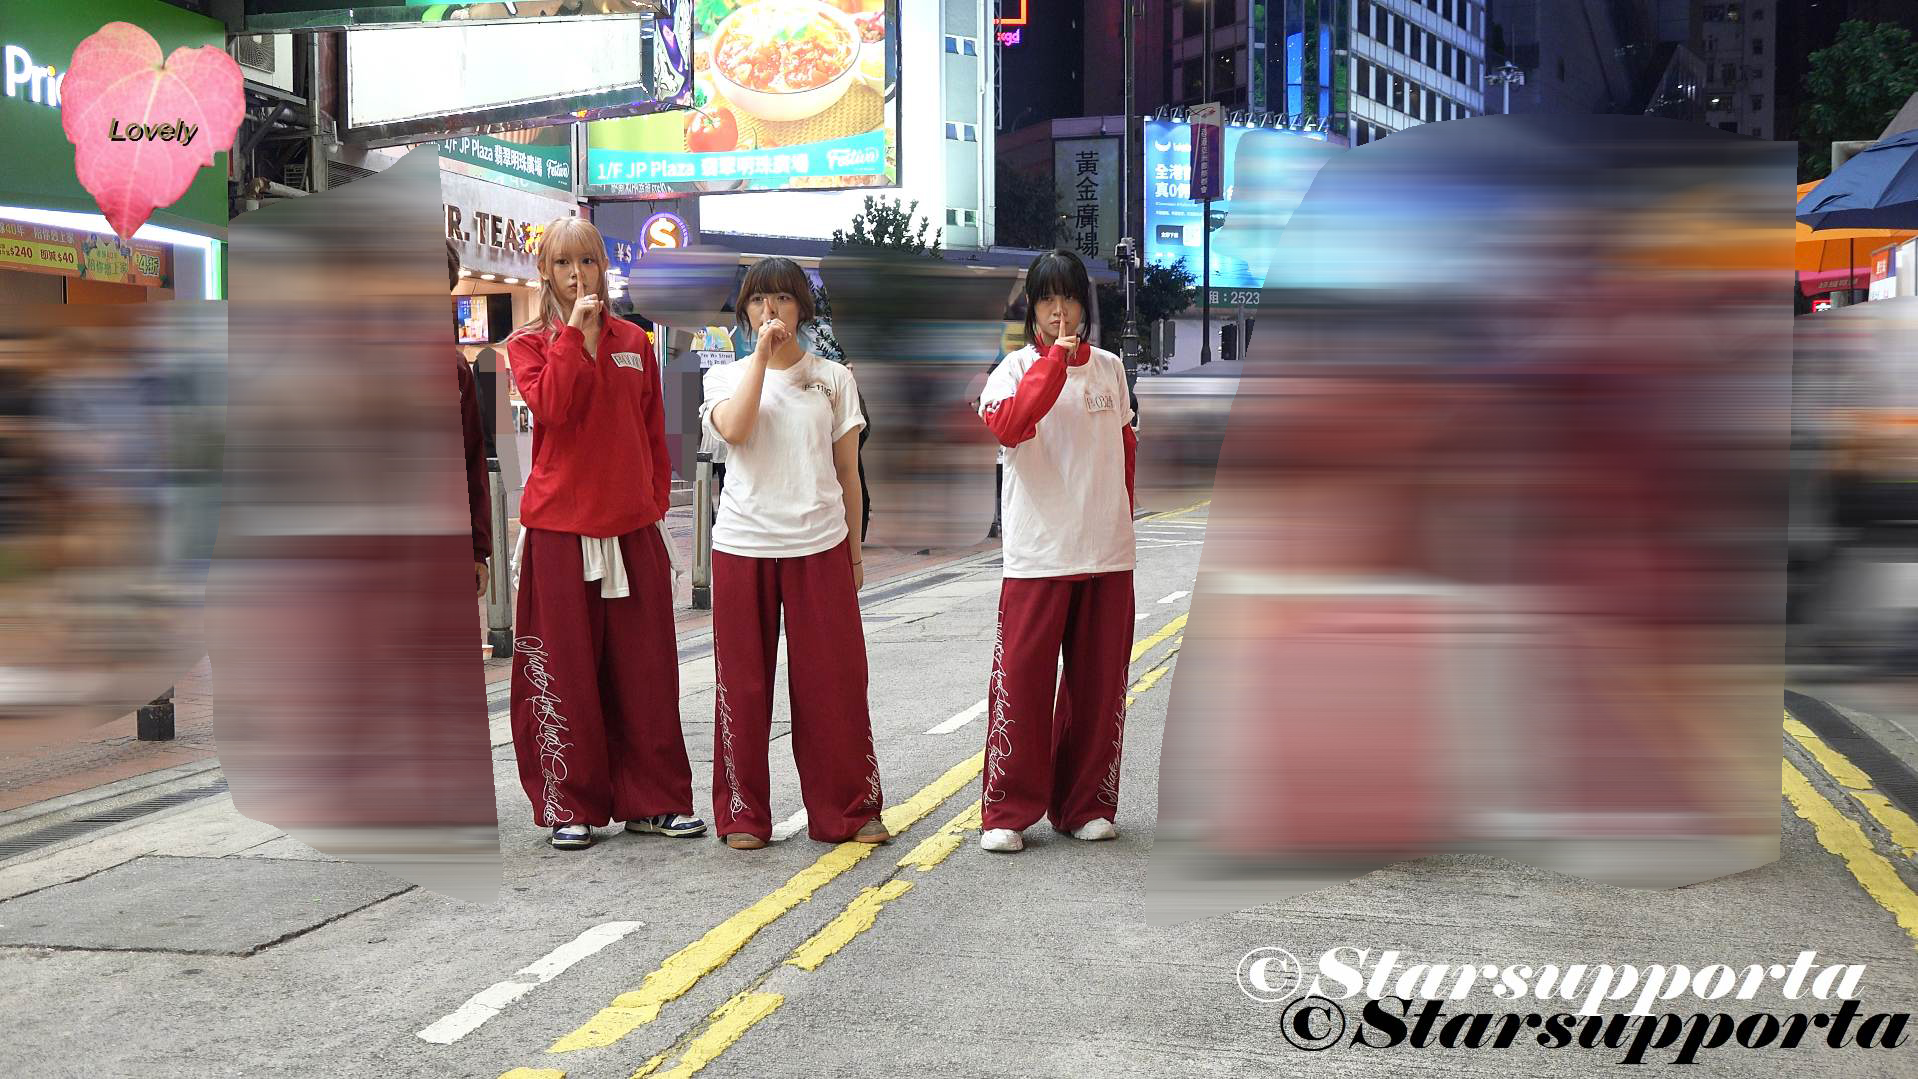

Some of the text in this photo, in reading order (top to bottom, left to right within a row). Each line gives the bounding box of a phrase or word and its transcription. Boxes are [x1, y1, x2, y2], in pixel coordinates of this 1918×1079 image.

[459, 136, 470, 155] JP
[472, 138, 494, 162] Plaza
[597, 162, 623, 180] 1/F
[626, 162, 647, 179] JP
[650, 159, 695, 177] Plaza
[1075, 150, 1099, 259] 黃金廣場
[443, 204, 520, 252] R. TEA
